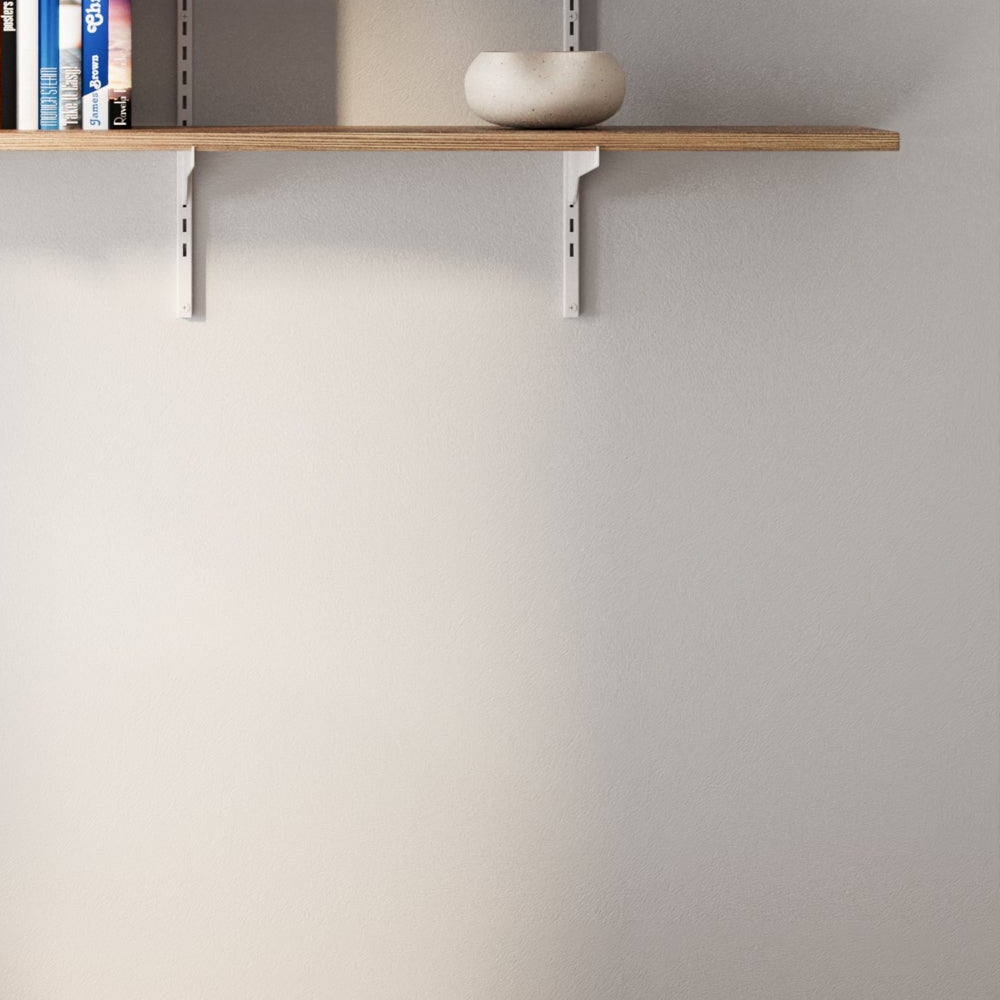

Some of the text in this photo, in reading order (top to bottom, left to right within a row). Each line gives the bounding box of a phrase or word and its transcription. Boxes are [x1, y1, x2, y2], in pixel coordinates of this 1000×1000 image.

[1, 1, 16, 32] posters
[40, 96, 58, 126] MONICA
[61, 66, 81, 126] Take Easy!
[89, 55, 102, 126] James Brown
